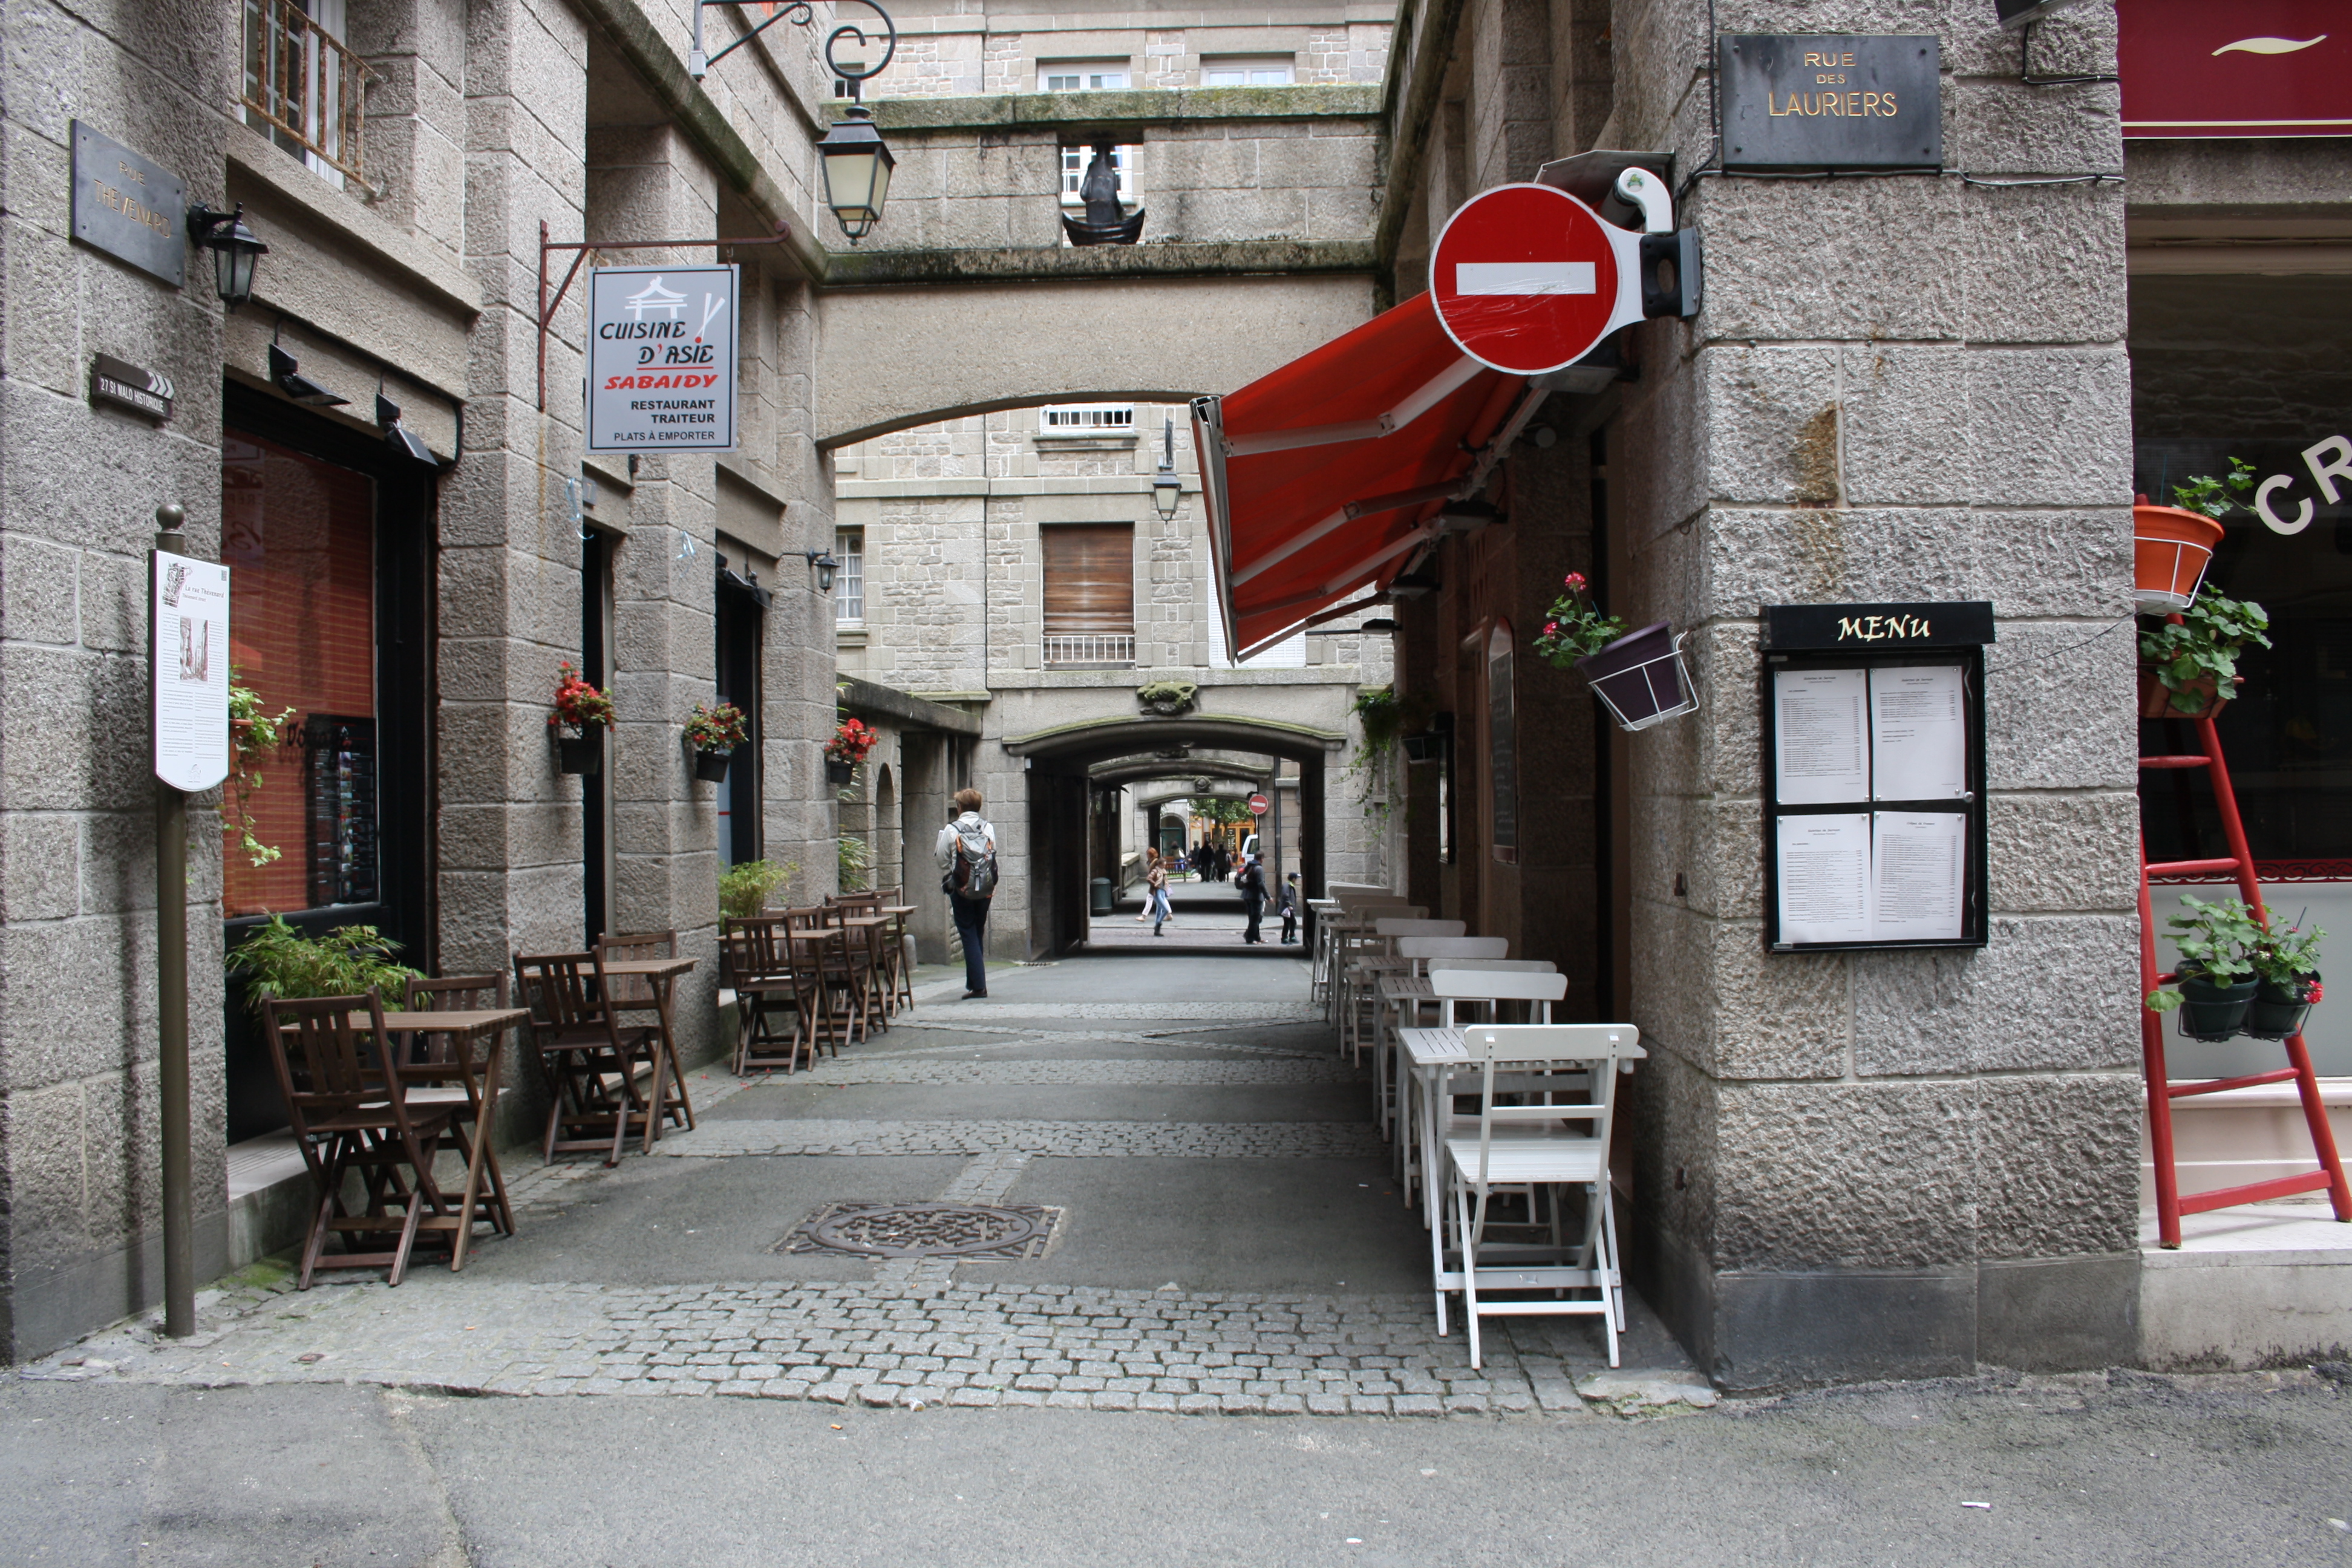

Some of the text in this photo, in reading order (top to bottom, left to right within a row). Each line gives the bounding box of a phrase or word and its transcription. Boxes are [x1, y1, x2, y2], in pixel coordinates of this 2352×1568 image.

[1804, 52, 1857, 67] RUE
[1816, 74, 1845, 84] DES
[1768, 91, 1898, 117] LAURIERS
[119, 160, 146, 186] RUE
[94, 178, 171, 238] THÉVENARD
[599, 321, 686, 339] CUISINE
[638, 343, 714, 364] D'ASIE
[604, 374, 719, 390] SABAIDY
[100, 377, 165, 413] 27 St MALO HISTORIQUE
[631, 400, 715, 410] RESTAURANT
[651, 414, 715, 423] TRAITEUR
[614, 430, 715, 441] PLATS À EMPORTER
[1837, 614, 1931, 642] MENU
